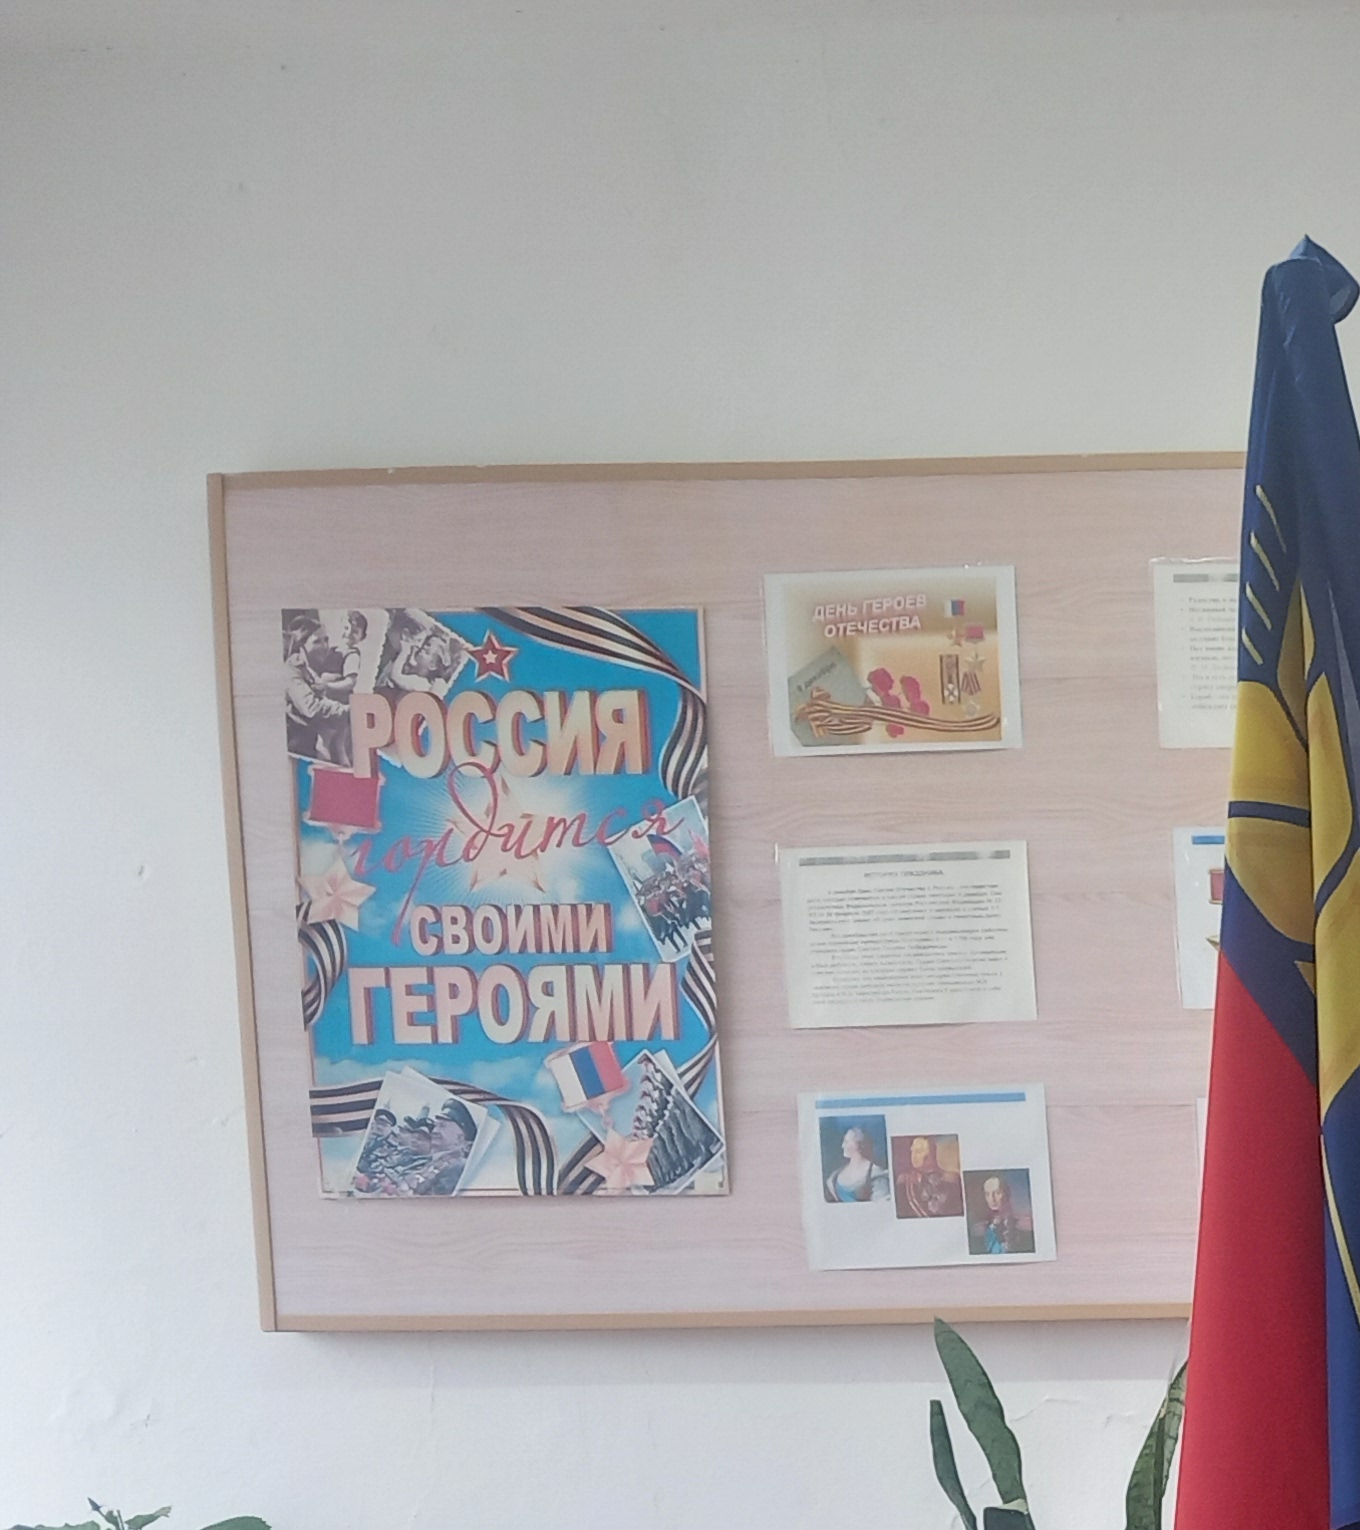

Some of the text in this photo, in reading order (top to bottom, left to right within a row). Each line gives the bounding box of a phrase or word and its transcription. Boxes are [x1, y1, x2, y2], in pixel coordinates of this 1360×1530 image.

[812, 594, 927, 622] ДЕНЬ ГЕРОЕВ
[824, 615, 921, 638] ОТЕЧЕСТВА
[348, 689, 650, 779] РОССИЯ
[350, 760, 686, 946] гордится
[410, 902, 614, 956] СВОИМИ
[347, 963, 682, 1045] ГЕРОЯМИ
